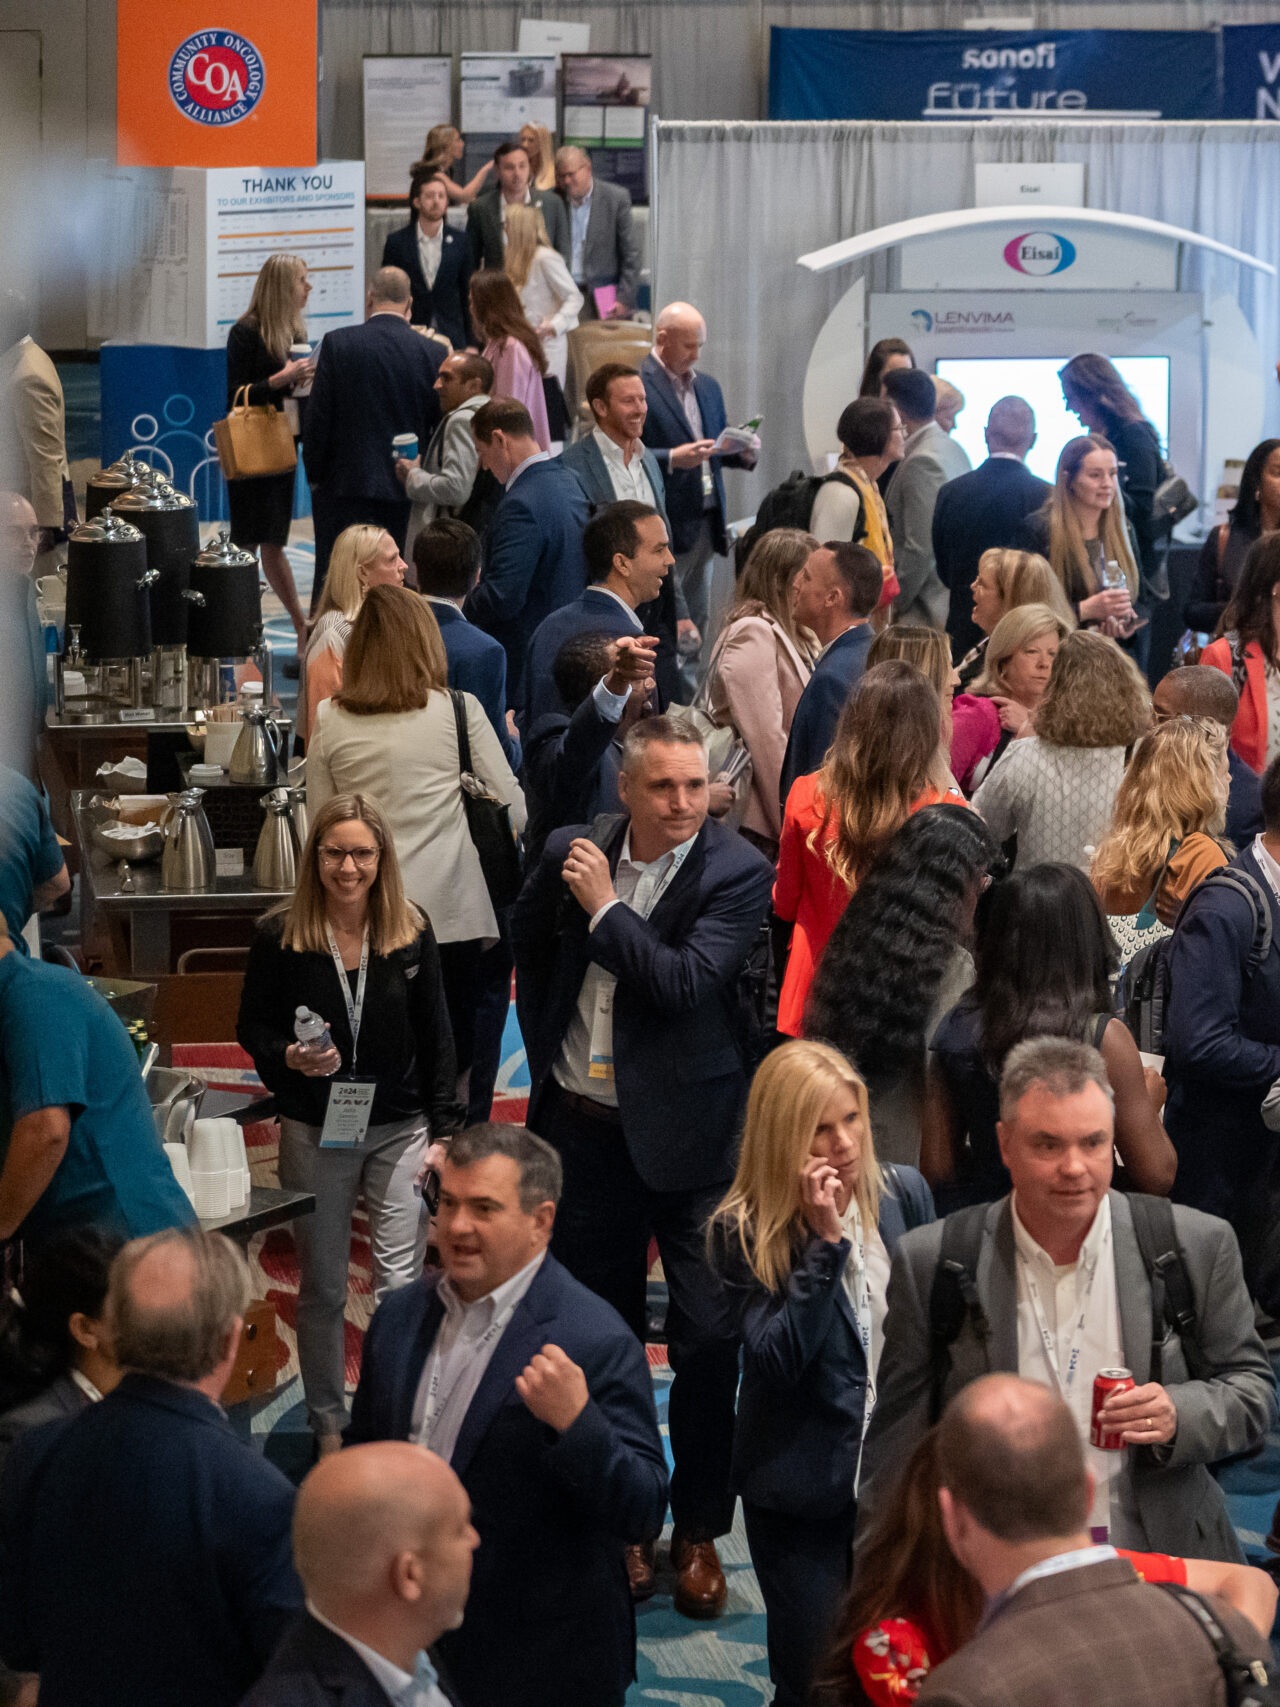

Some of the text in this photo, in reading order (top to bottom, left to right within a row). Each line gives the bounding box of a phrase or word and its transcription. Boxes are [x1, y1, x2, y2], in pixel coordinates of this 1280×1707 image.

[962, 43, 1056, 69] sanofi
[172, 33, 262, 101] COMMUNITY ONCOLOGY
[187, 53, 247, 101] COA
[184, 102, 248, 123] ALLIANCE
[242, 175, 333, 193] THANK YOU
[218, 198, 228, 207] TO
[1021, 246, 1059, 261] Eisai
[935, 312, 1014, 324] LENVIMA
[673, 853, 685, 870] 2024
[862, 1326, 870, 1347] 2024
[1069, 1348, 1079, 1370] 2024
